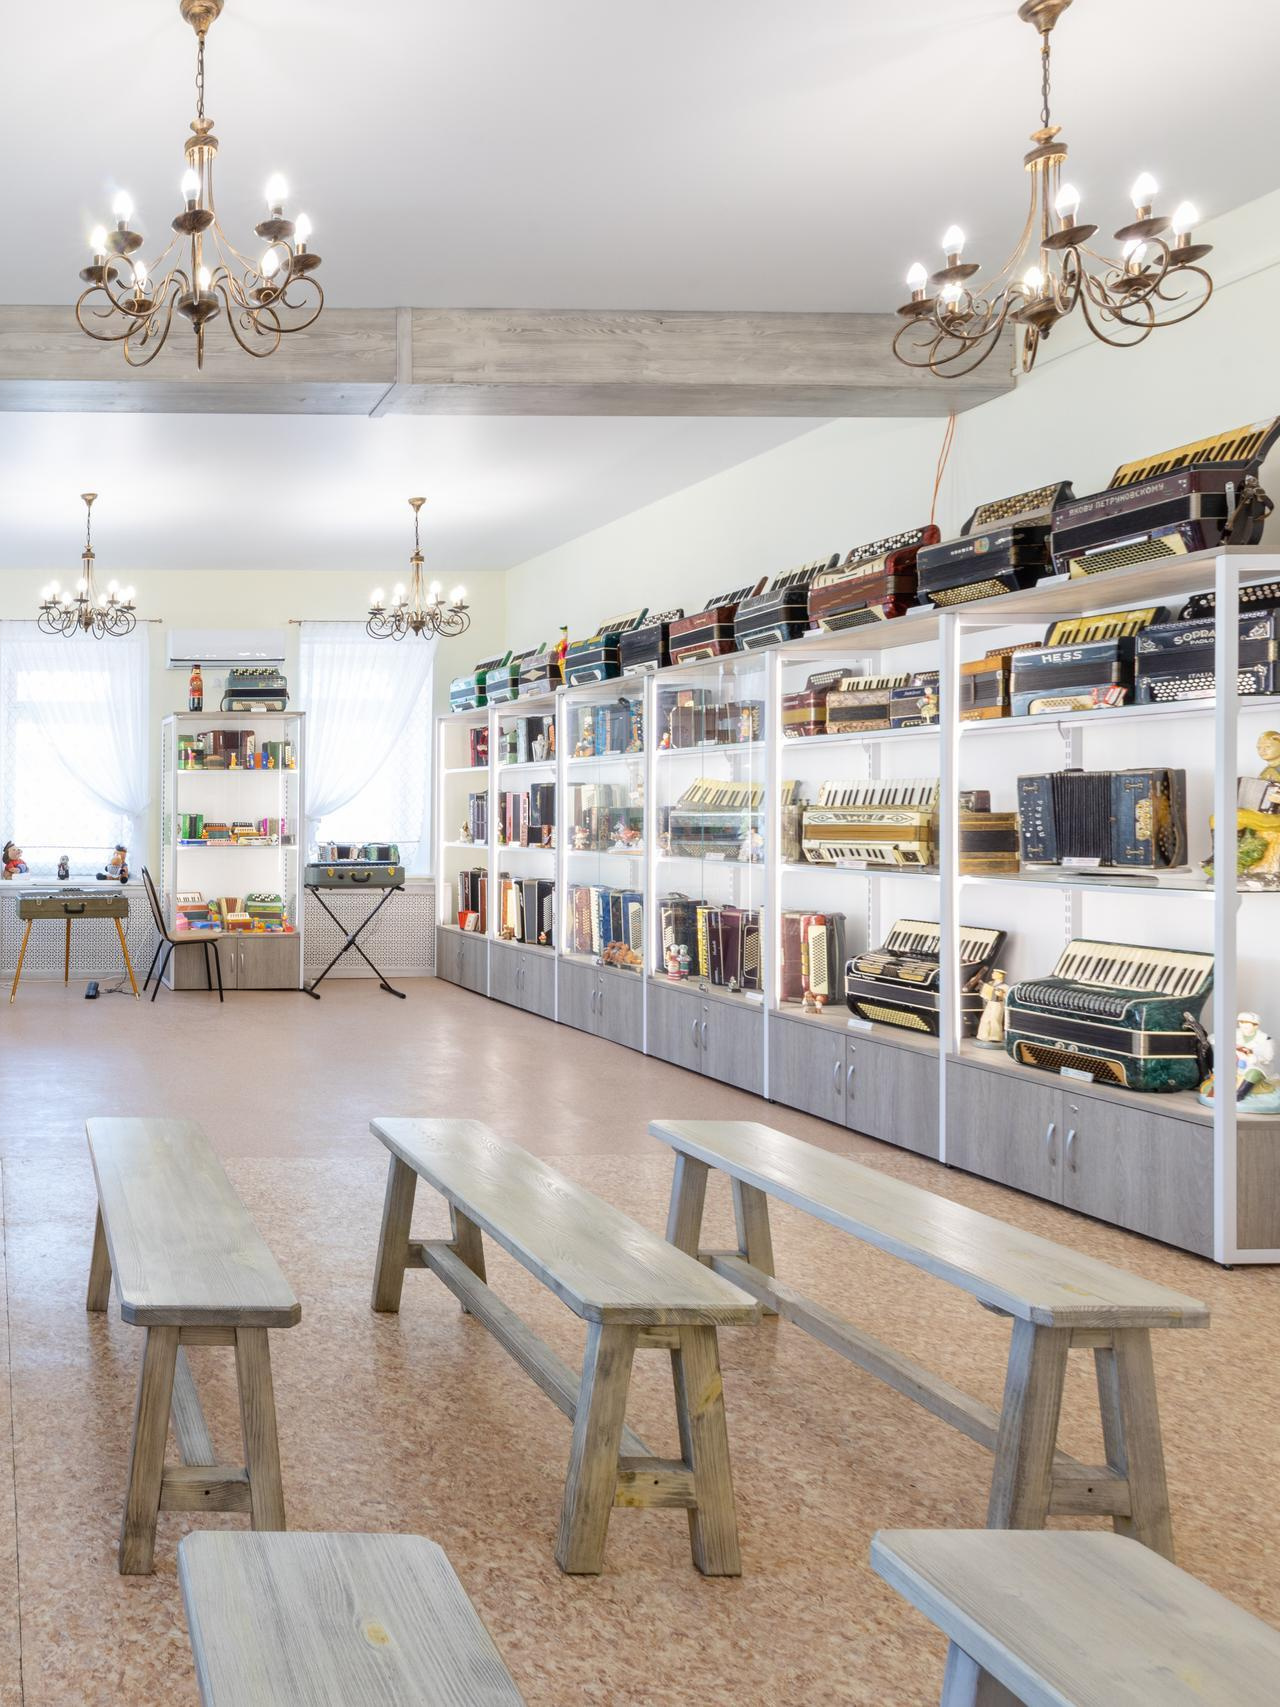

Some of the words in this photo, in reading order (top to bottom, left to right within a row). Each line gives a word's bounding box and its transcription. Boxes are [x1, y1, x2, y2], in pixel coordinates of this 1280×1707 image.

[1068, 503, 1093, 516] ЯКОВУ
[1173, 629, 1216, 645] SOPRA
[1041, 650, 1082, 664] HESS
